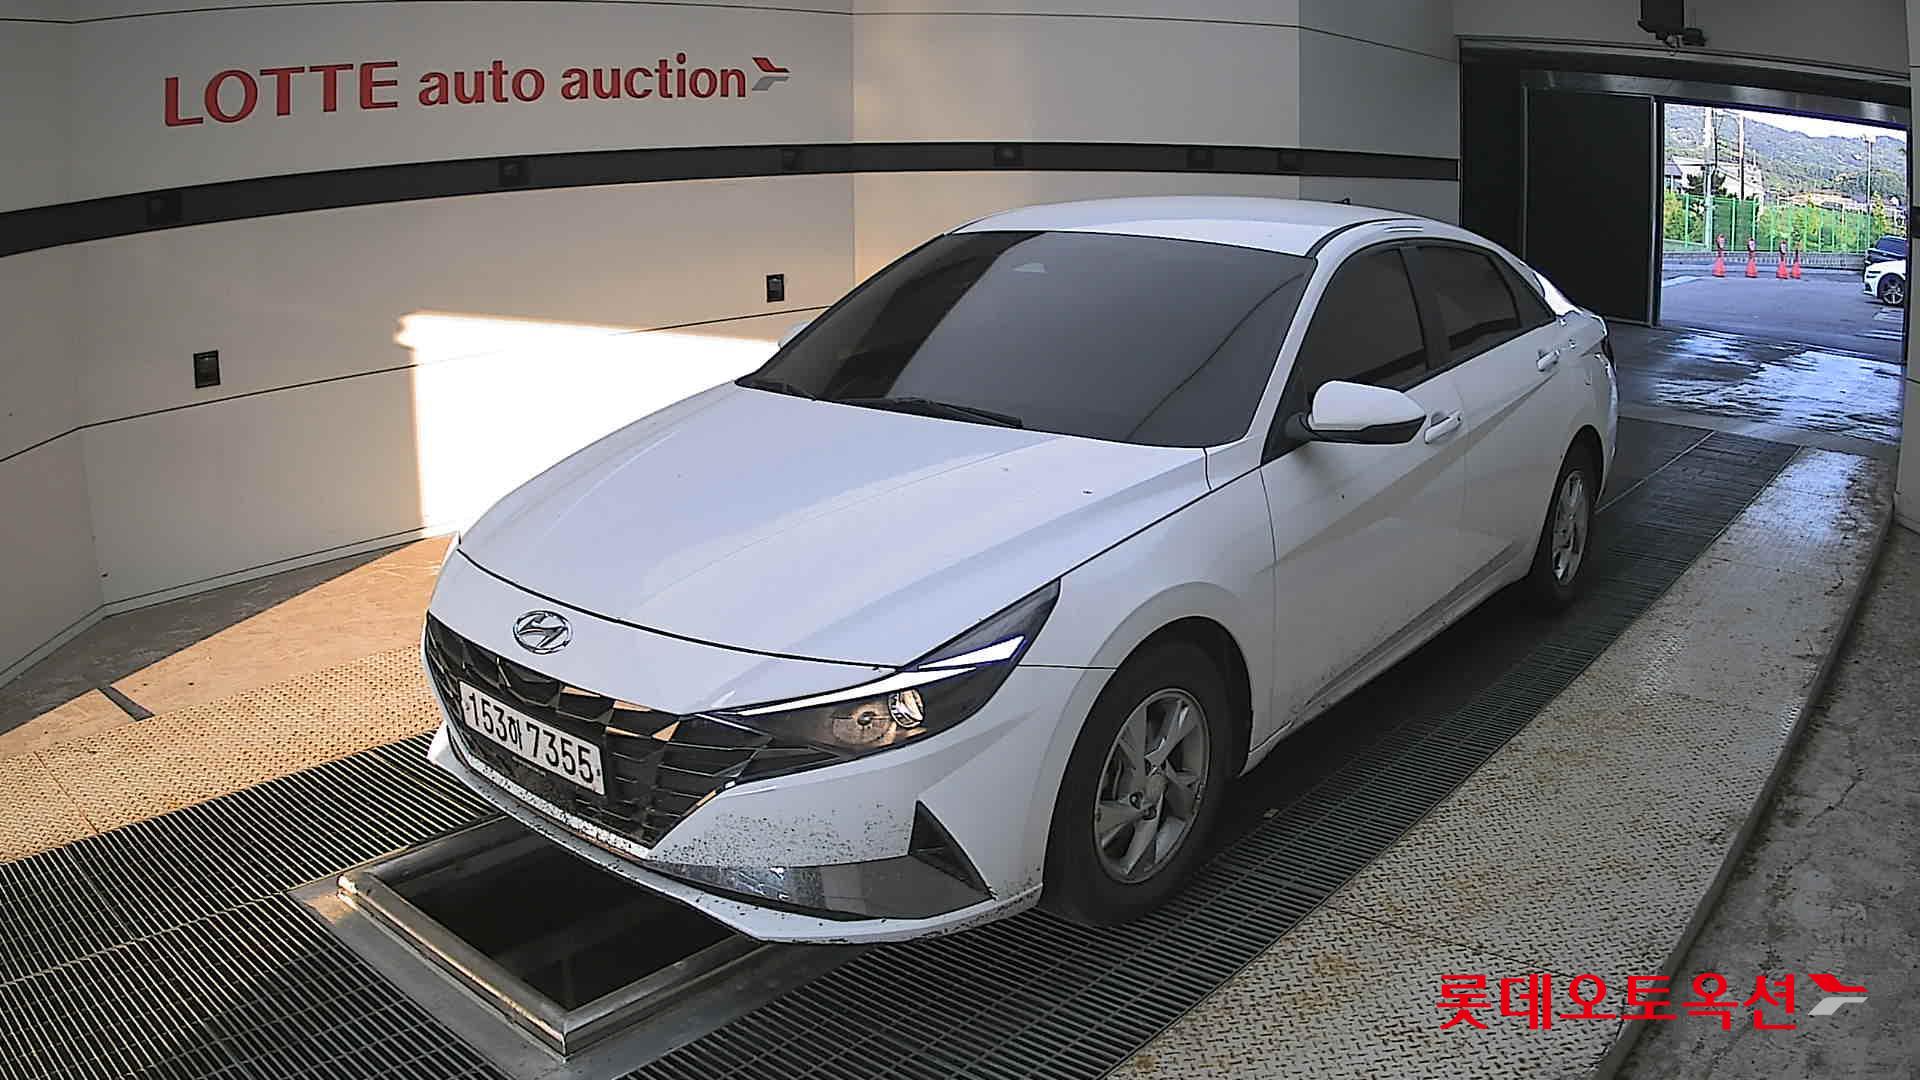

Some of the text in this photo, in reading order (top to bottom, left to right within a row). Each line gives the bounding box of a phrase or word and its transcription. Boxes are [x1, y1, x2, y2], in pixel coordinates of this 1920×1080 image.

[164, 52, 747, 127] LOTTE auto auction
[526, 721, 595, 785] 7355
